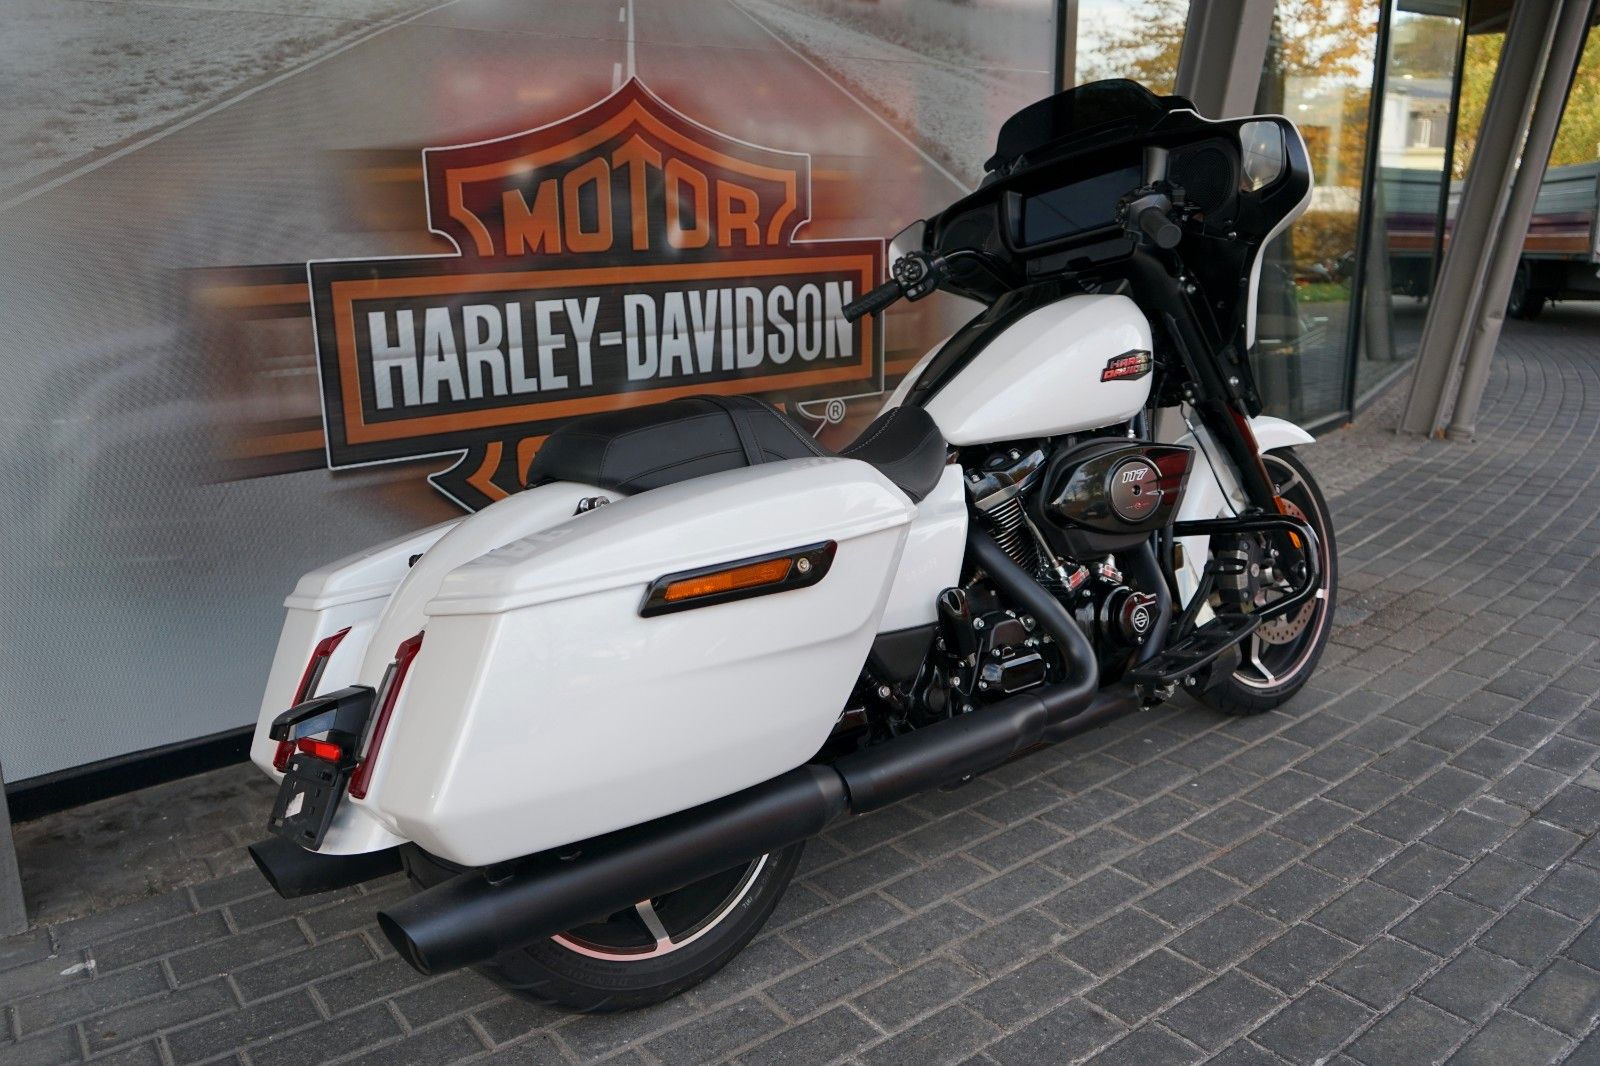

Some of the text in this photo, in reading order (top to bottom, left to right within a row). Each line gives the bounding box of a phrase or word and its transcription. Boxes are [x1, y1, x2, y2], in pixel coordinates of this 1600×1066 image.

[502, 133, 761, 256] MOTOR
[368, 281, 853, 410] HARLEY-DAVIDSON
[1122, 468, 1149, 483] 117
